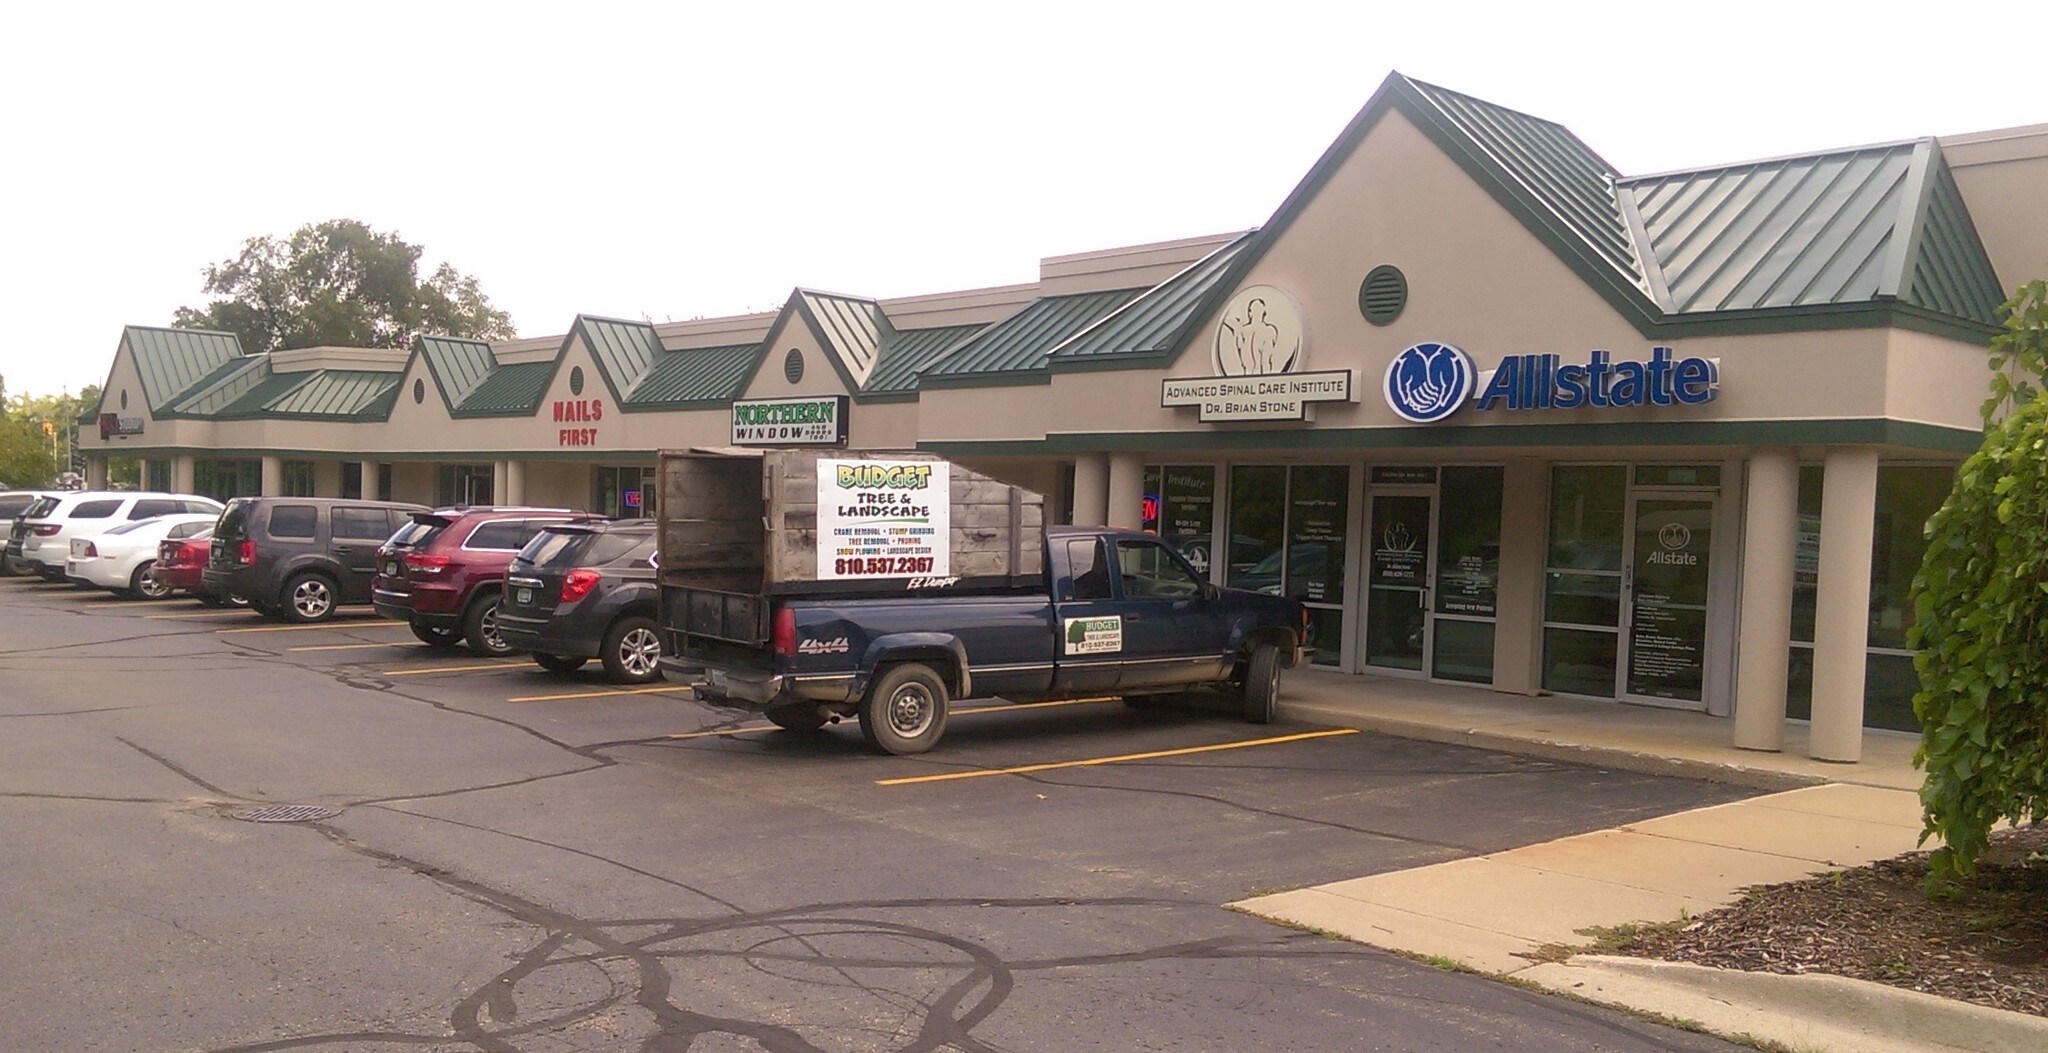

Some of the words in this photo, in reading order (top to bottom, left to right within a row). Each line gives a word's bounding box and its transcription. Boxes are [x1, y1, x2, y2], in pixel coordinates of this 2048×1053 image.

[1475, 347, 1713, 411] Allstate
[1166, 386, 1217, 399] ADVANCED
[1219, 384, 1256, 397] SPINAL
[1258, 383, 1286, 395] CARE
[1289, 381, 1344, 394] INSTITUTE
[553, 399, 603, 422] NAILS
[734, 402, 836, 425] NORTHERN
[1225, 402, 1257, 413] BRIAN
[1259, 402, 1295, 412] STONE
[559, 428, 598, 446] FIRST
[736, 427, 804, 439] WINDOW
[837, 464, 933, 490] BUDGET
[857, 492, 897, 504] TREE
[900, 492, 912, 505] &
[837, 505, 930, 518] LANDSCAPE
[848, 538, 862, 546] TREE
[835, 557, 934, 575] 810.537.2367
[1646, 551, 1697, 566] Allstate
[1086, 620, 1118, 631] BUDGET
